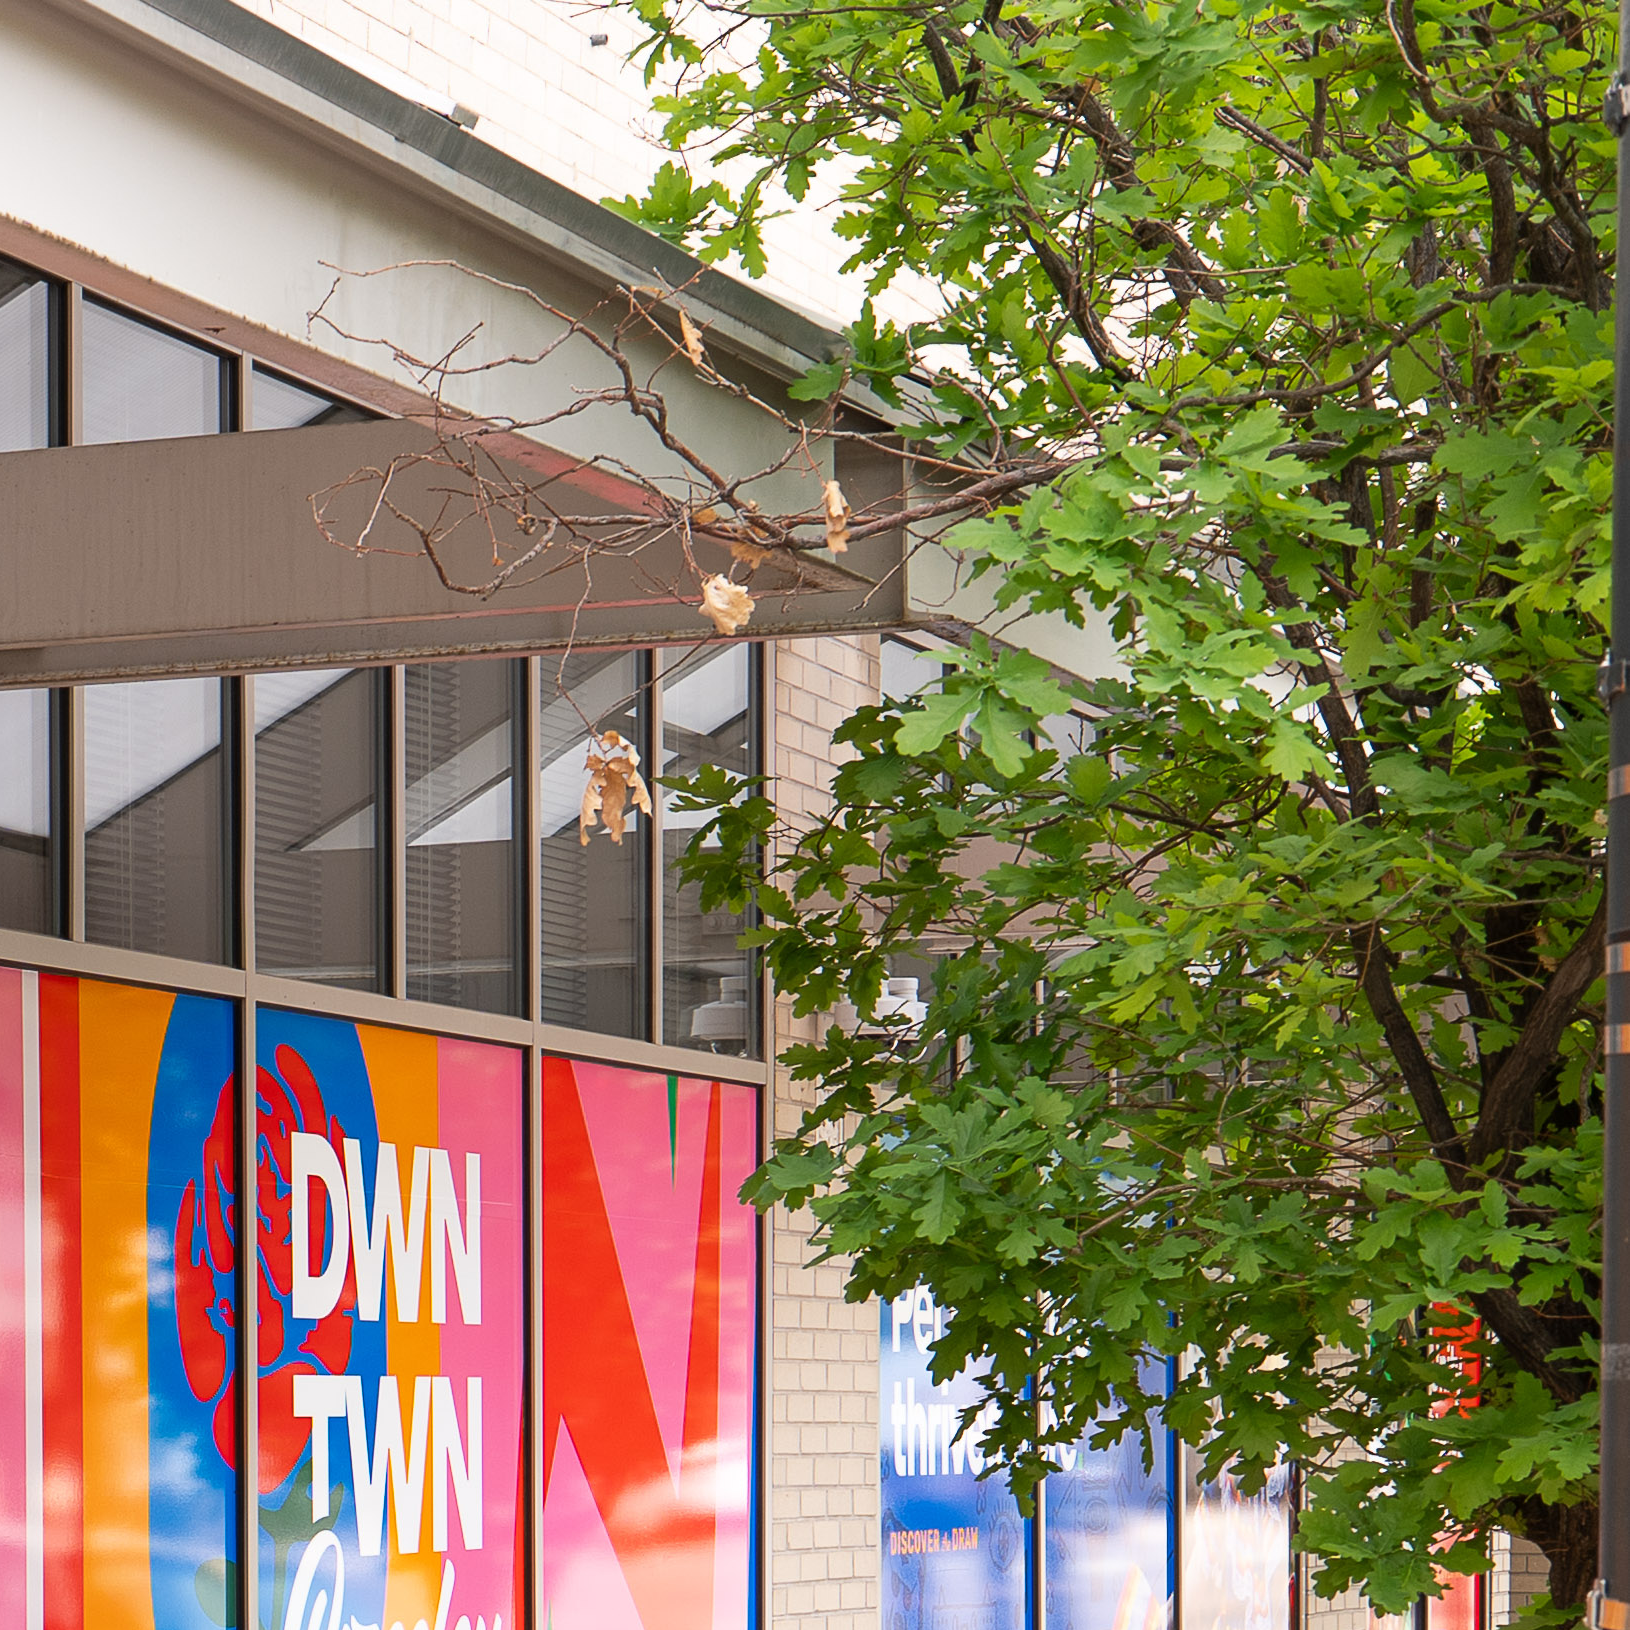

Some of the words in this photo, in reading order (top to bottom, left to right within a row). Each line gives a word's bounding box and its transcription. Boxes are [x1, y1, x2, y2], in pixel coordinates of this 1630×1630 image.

[290, 1130, 482, 1326] DWN
[292, 1374, 483, 1558] TWN
[890, 1528, 940, 1556] DISCOVER
[952, 1526, 979, 1552] DRAW
